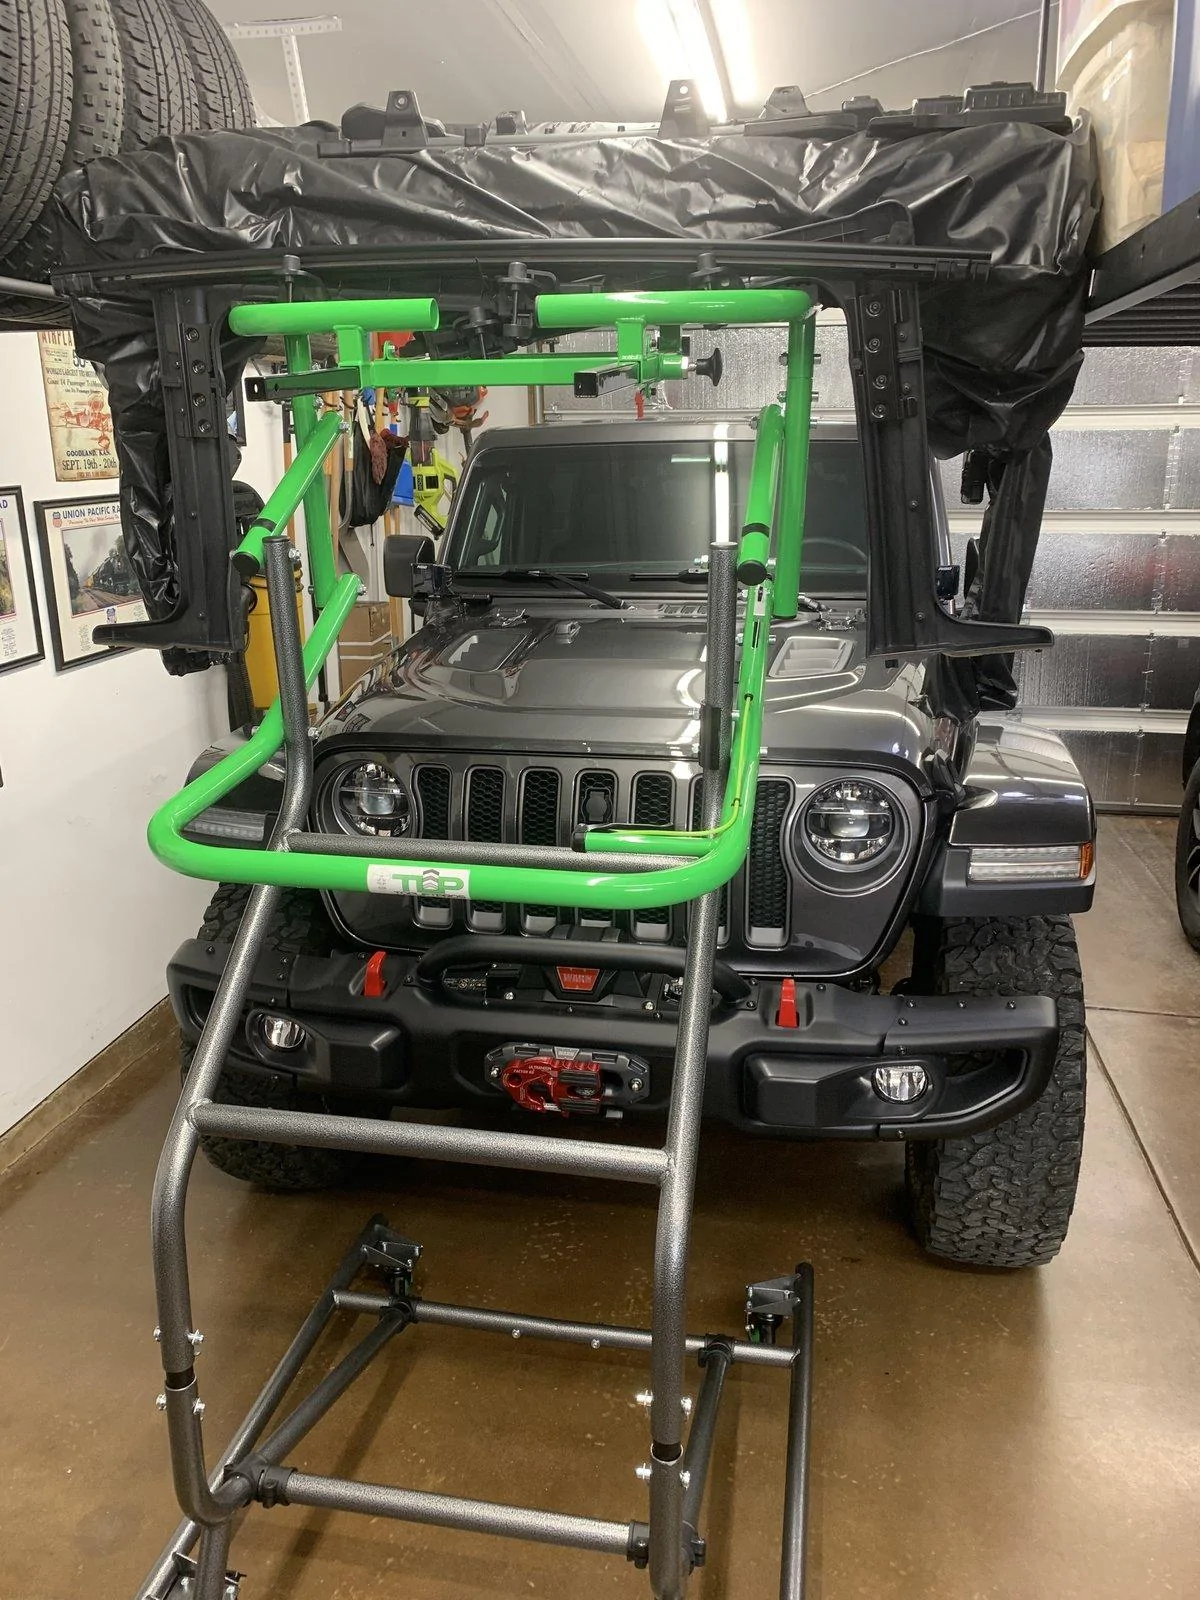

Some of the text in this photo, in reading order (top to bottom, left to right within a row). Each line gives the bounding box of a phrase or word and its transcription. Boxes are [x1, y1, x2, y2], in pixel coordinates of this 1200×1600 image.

[62, 459, 82, 470] SEPT.
[83, 458, 98, 470] 19th
[62, 508, 86, 519] UNION
[87, 505, 110, 516] PACIFIC
[563, 973, 593, 983] WARN
